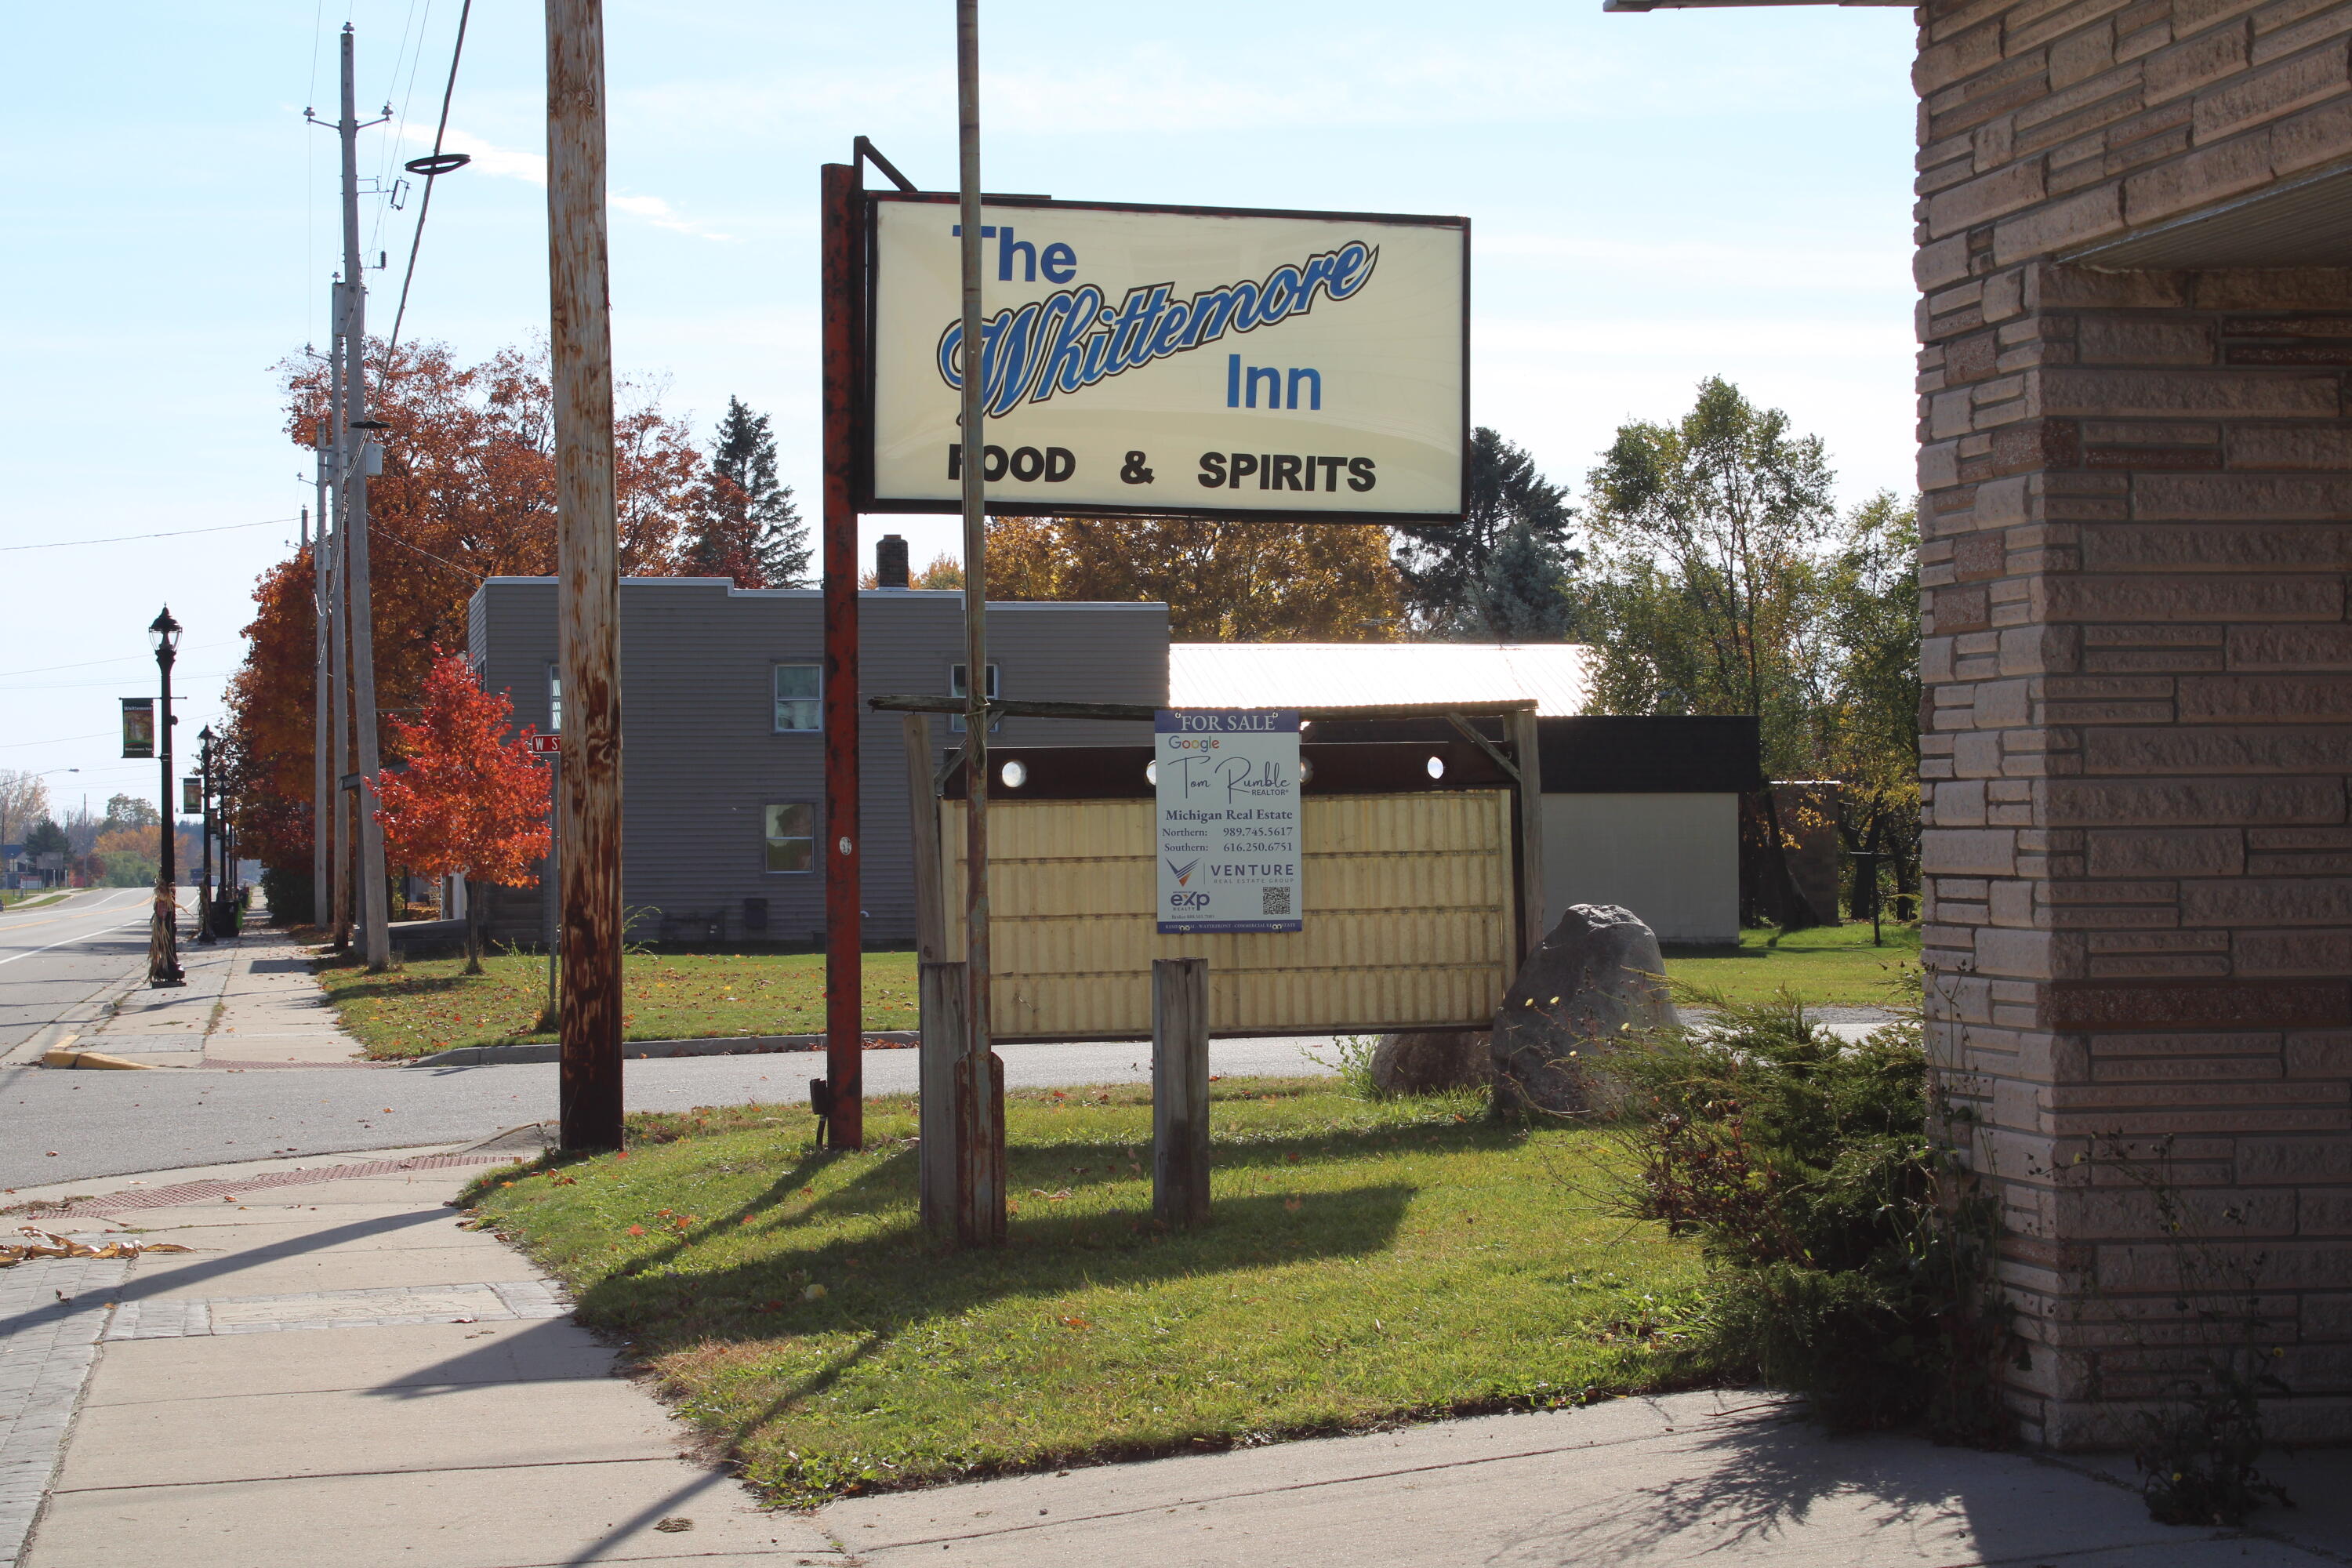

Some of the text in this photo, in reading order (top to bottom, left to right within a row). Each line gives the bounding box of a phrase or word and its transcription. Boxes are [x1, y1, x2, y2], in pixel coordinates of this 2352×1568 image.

[937, 240, 1380, 426] Whittemore
[1227, 354, 1321, 410] Inn
[1120, 450, 1155, 485] &
[1198, 452, 1377, 492] SPIRITS
[1181, 715, 1276, 731] FOR SALE
[535, 737, 561, 751] W S
[1168, 735, 1220, 753] Google
[1167, 756, 1290, 804] Tom Rumble
[1166, 809, 1293, 824] Michigan Real Estate
[1162, 827, 1293, 837] Northern: 989.745.5617
[1164, 842, 1293, 852] Southern: 616.250.6751
[1210, 864, 1294, 876] VENTURE
